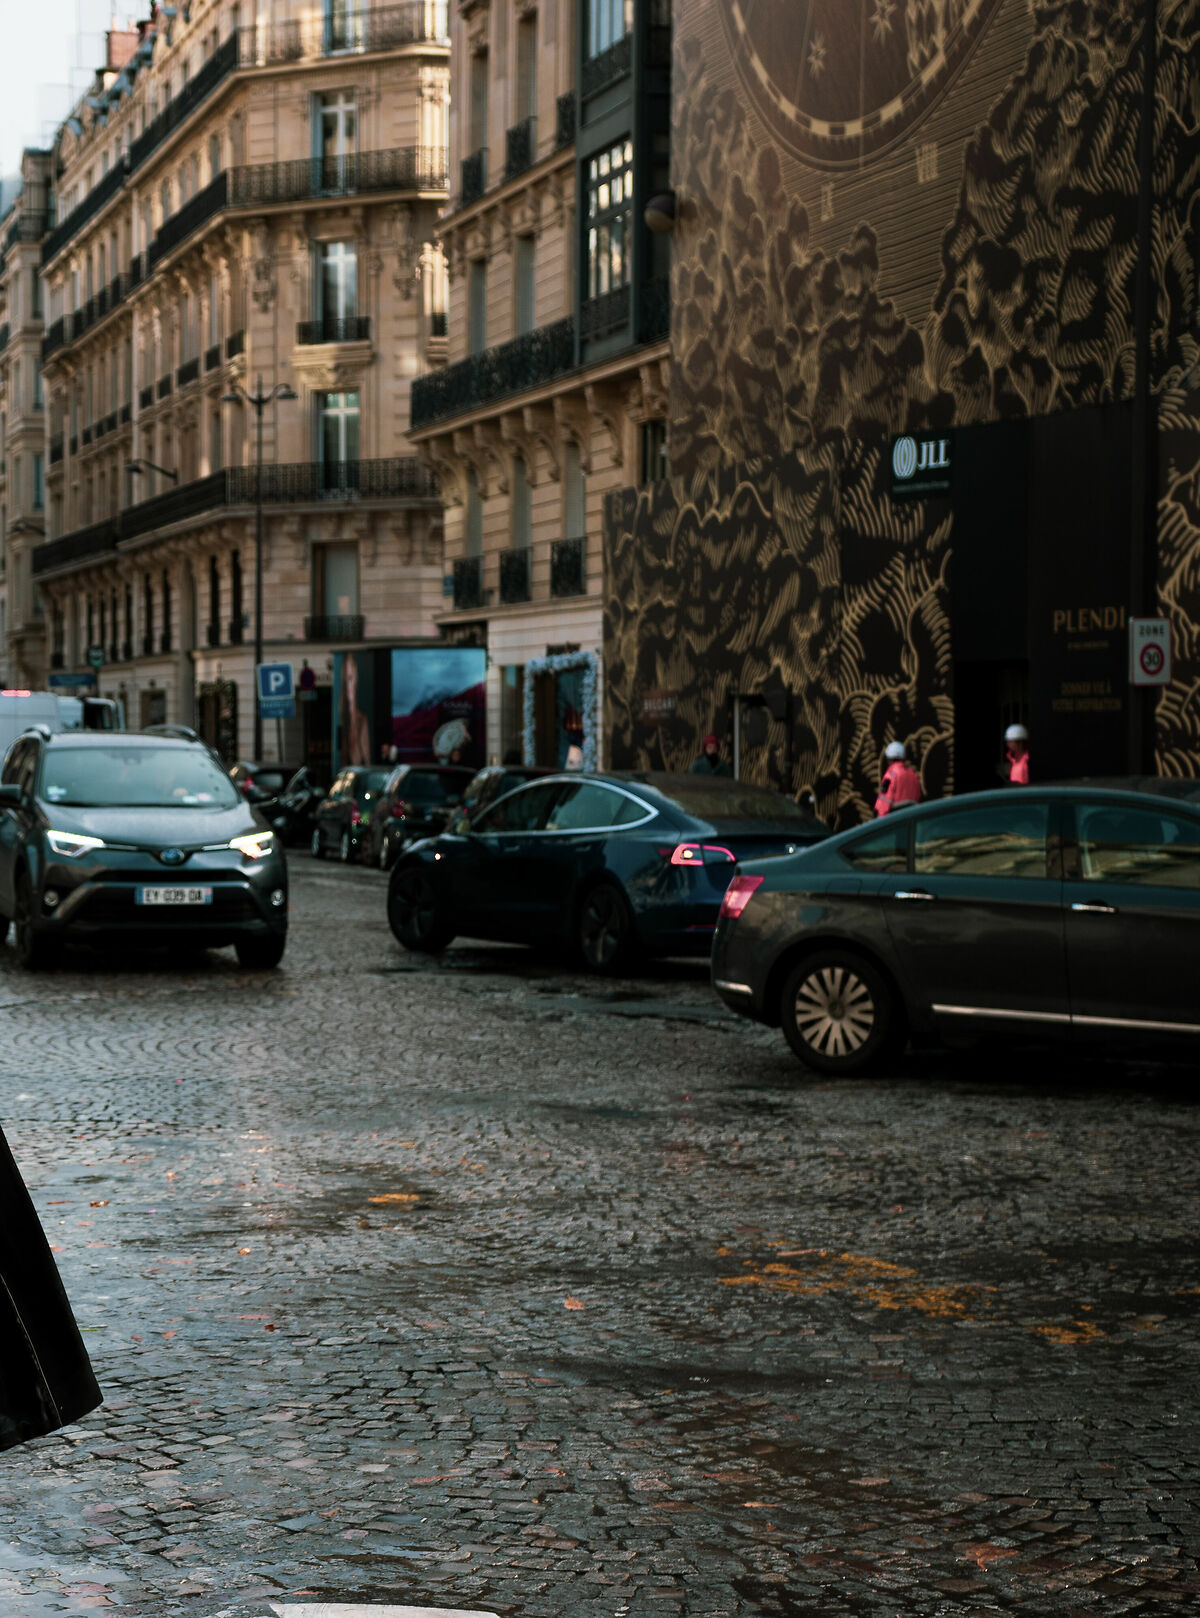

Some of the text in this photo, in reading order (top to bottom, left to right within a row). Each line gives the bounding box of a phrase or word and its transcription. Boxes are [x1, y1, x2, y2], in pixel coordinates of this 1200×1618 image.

[917, 440, 950, 470] JLL
[1139, 624, 1165, 637] ZONE
[1145, 652, 1160, 666] 30
[268, 671, 285, 693] P
